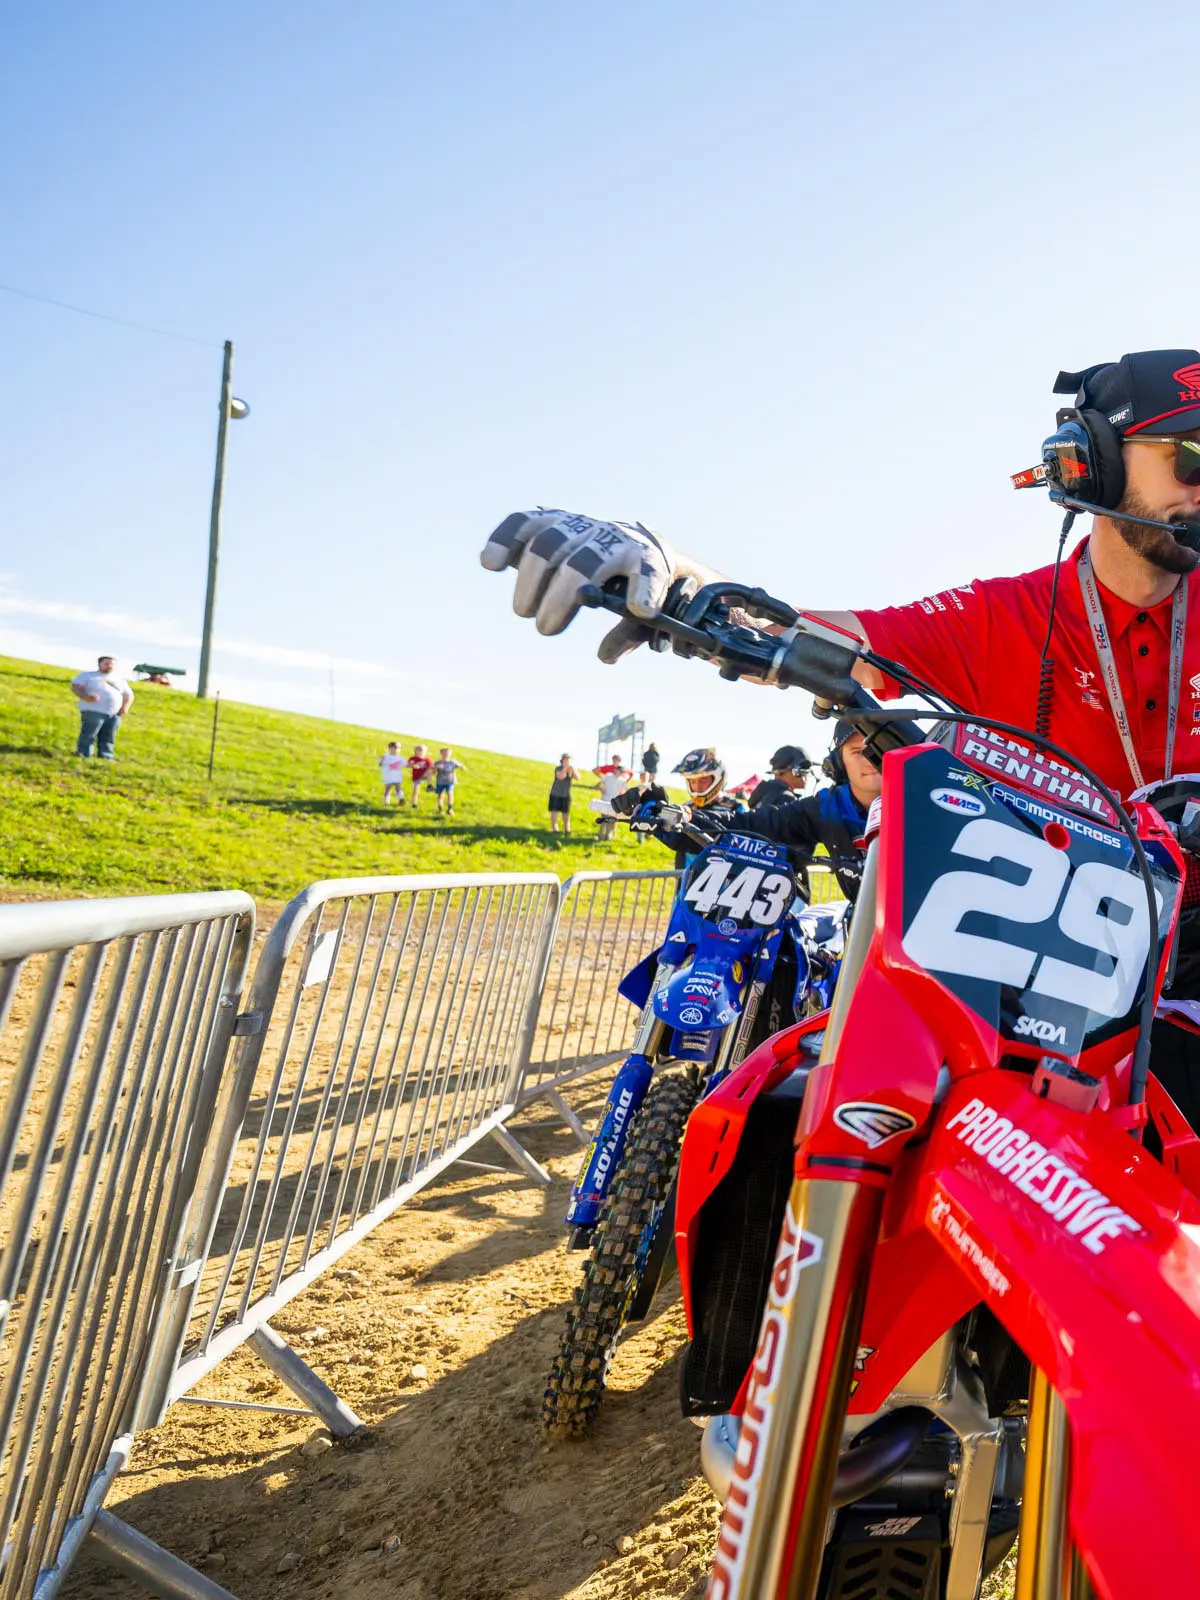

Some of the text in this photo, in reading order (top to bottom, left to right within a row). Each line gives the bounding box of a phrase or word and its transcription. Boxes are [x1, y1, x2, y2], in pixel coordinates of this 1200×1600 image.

[936, 793, 967, 809] AMA
[947, 768, 985, 791] SMX
[962, 739, 1108, 818] RENTHAL
[684, 861, 792, 926] 443
[901, 818, 1164, 1019] 29
[1012, 1015, 1067, 1046] SKDA
[594, 1088, 633, 1190] DUNLOP
[946, 1098, 1142, 1255] PROGRESSIVE
